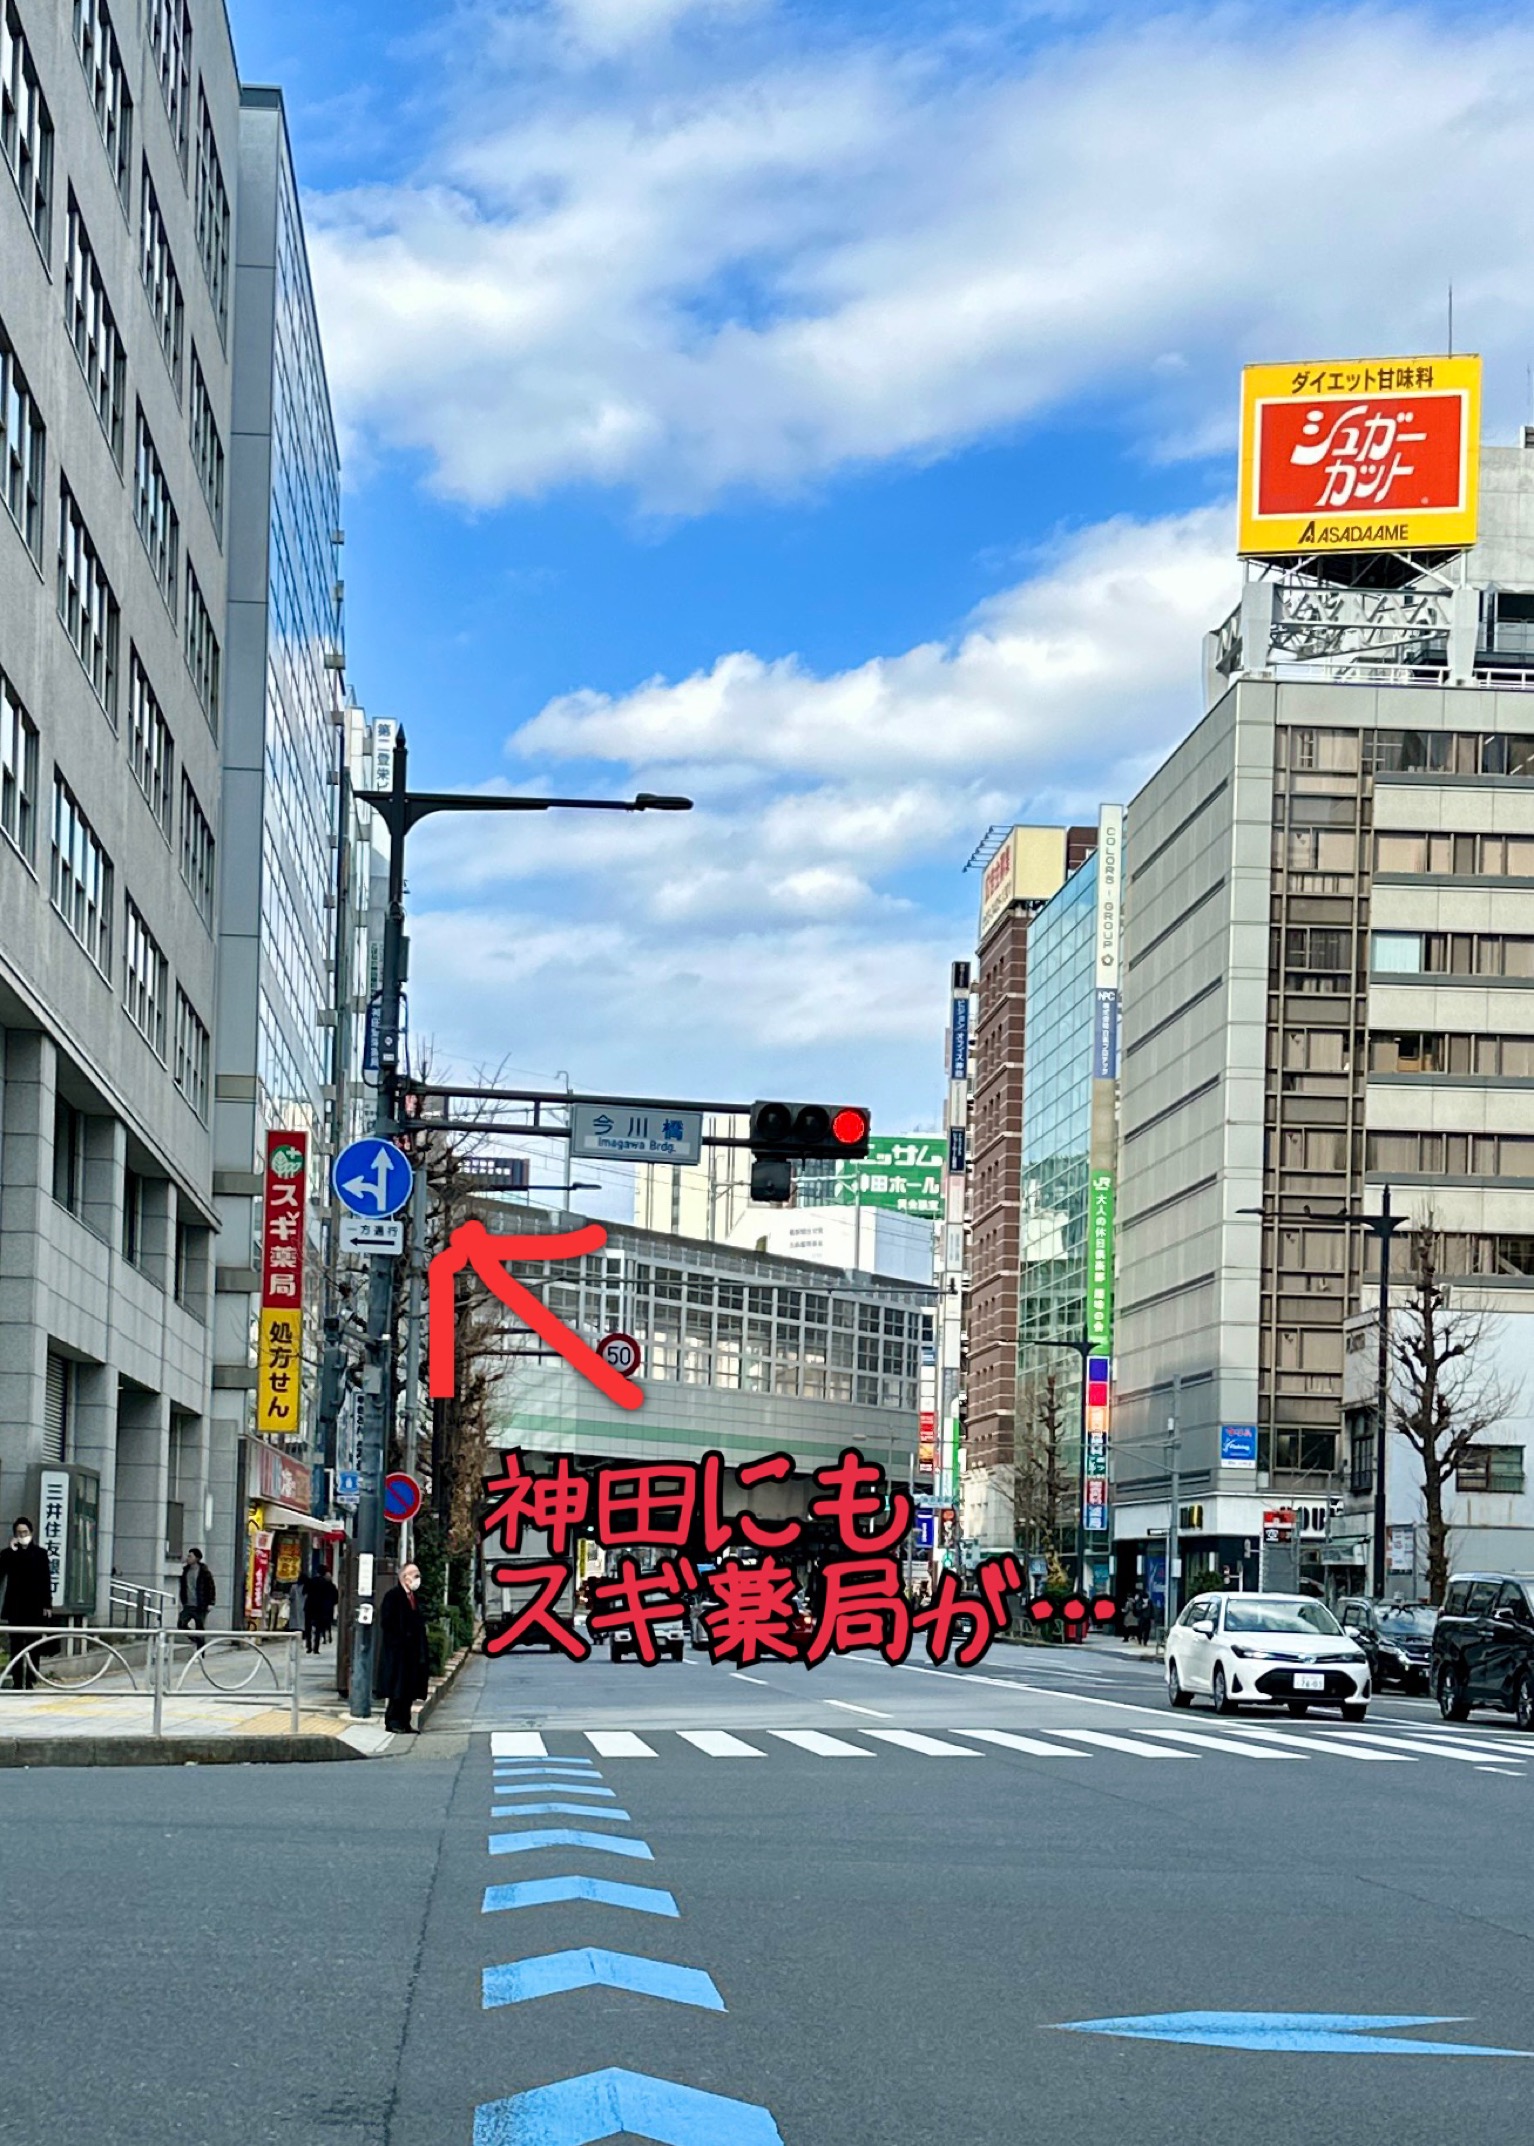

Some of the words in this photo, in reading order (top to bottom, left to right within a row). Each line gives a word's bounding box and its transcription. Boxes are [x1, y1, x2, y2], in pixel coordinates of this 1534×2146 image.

[1291, 366, 1434, 393] ダイエット甘味料
[1290, 405, 1427, 465] シュガー
[1314, 452, 1414, 507] カット
[1317, 523, 1409, 543] ASADAAME
[1102, 901, 1114, 949] GROUP
[593, 1114, 684, 1141] 今川橋
[599, 1137, 646, 1151] Imagawa
[649, 1138, 677, 1153] Brdg.
[1093, 1177, 1111, 1190] JR
[268, 1184, 300, 1296] スギ薬局
[347, 1225, 398, 1237] 一方通行
[267, 1321, 293, 1418] 処方せん
[607, 1346, 631, 1366] 50
